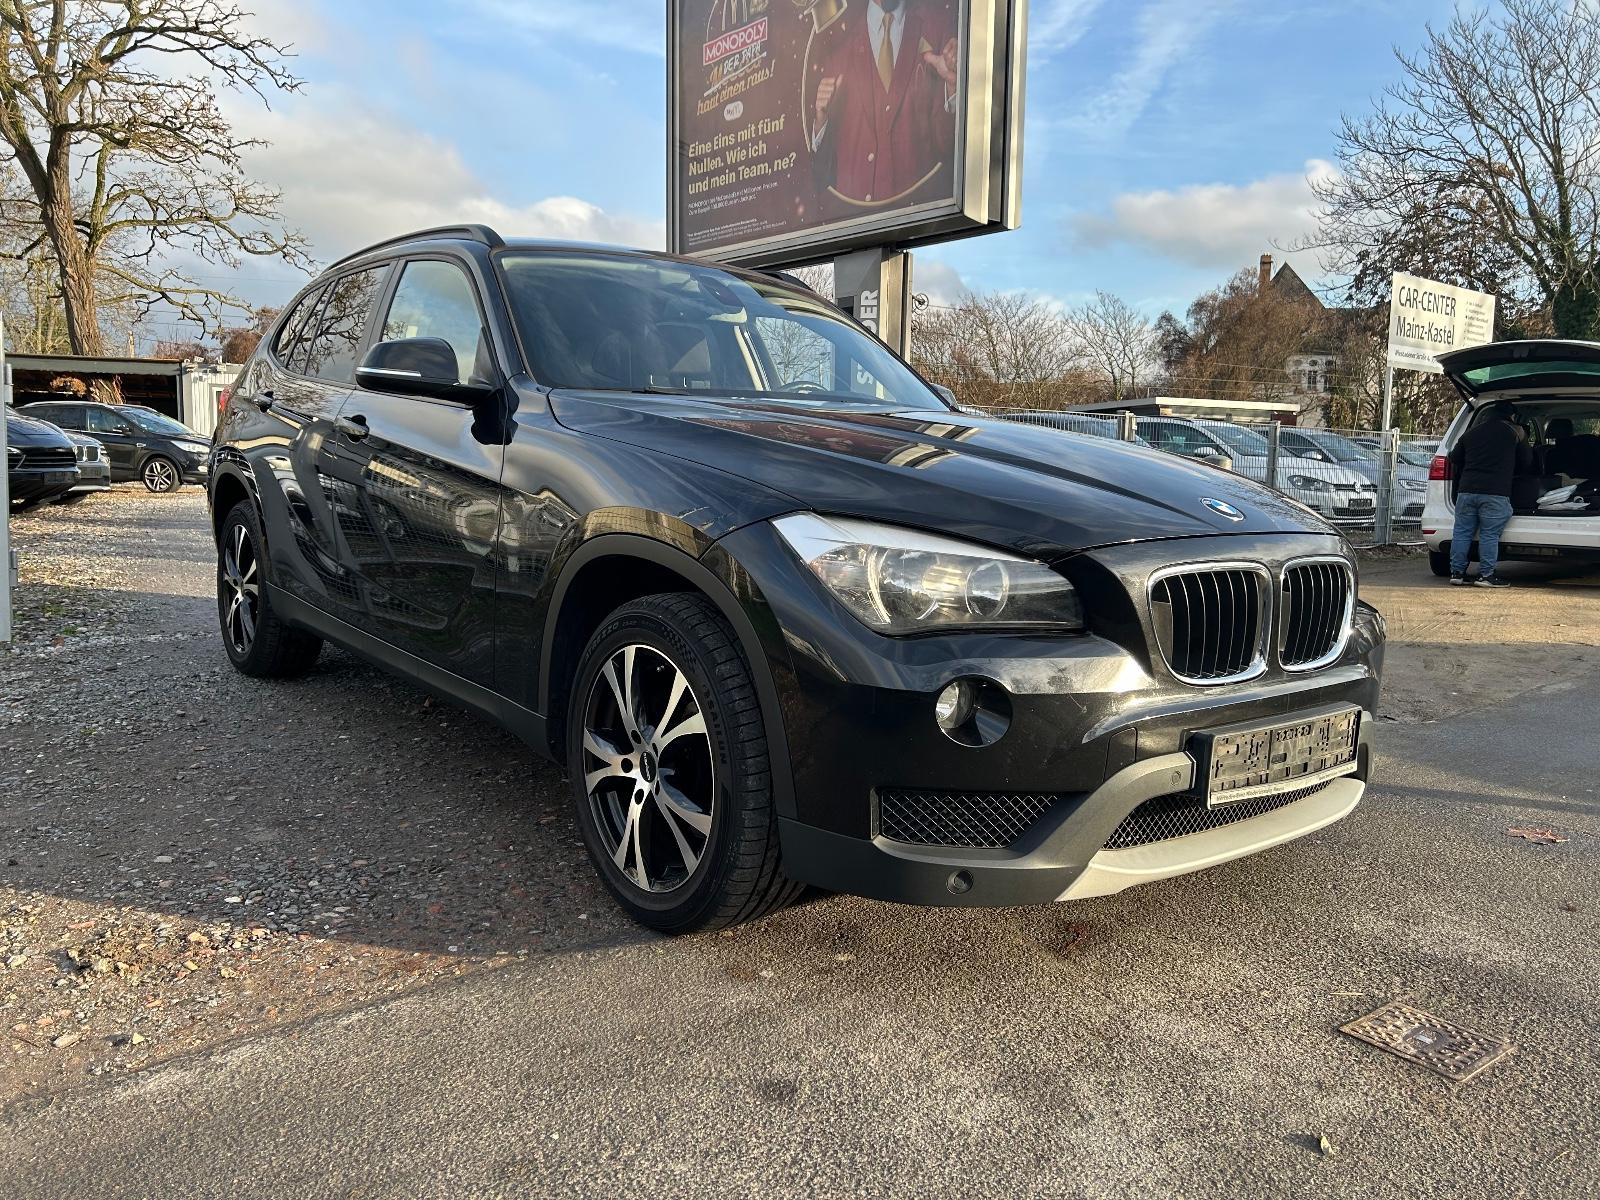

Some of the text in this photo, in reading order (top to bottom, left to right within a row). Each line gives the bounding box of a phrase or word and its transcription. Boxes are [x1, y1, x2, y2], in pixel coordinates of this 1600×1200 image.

[706, 21, 766, 61] MONOPOLY
[697, 92, 720, 116] haut
[720, 80, 746, 102] einen
[747, 59, 775, 90] raus!
[688, 114, 785, 158] Eine Eins mit fünf
[688, 140, 767, 177] Nullen. Wie ich
[688, 152, 797, 195] und mein Team, ne?
[1399, 285, 1457, 318] CAR-CENTER
[1396, 315, 1455, 345] Mainz-Kastel
